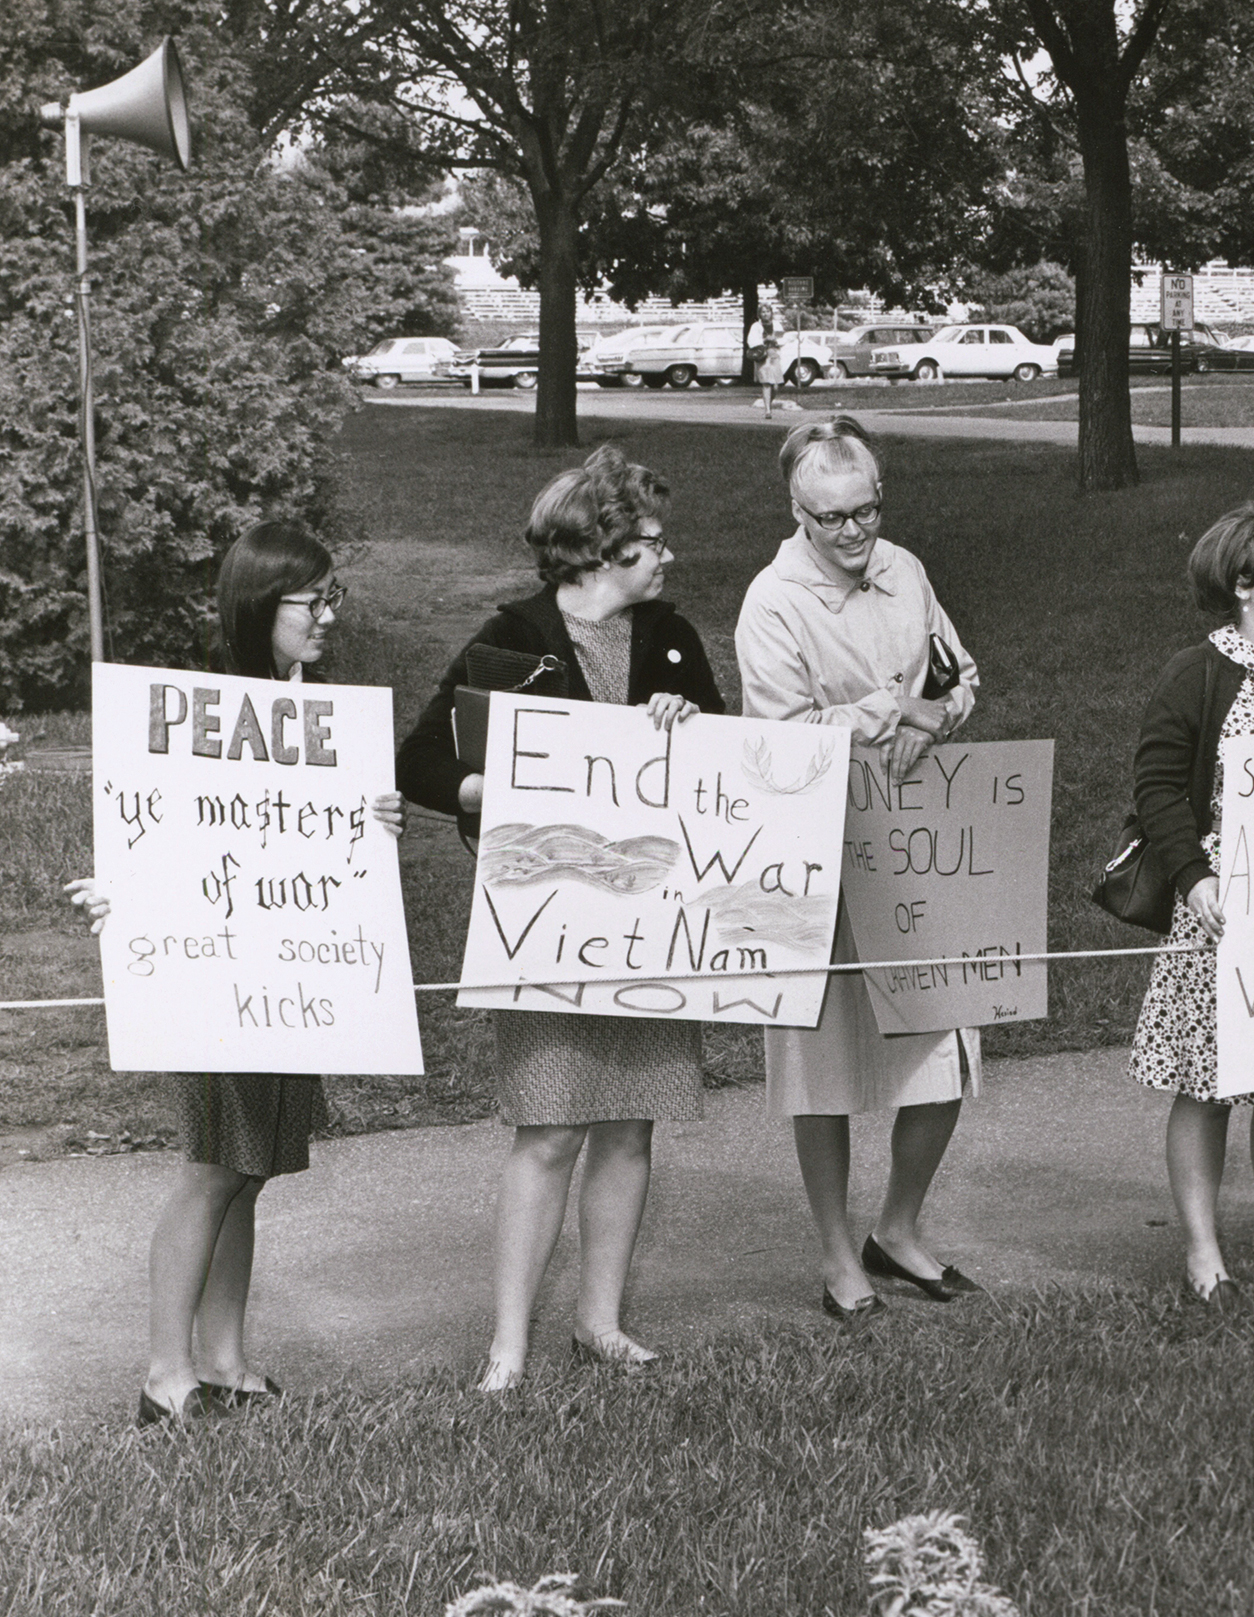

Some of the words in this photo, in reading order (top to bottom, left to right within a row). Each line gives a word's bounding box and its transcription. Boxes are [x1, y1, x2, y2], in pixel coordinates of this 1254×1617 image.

[1171, 279, 1185, 290] NO
[149, 683, 338, 767] PEACE
[511, 708, 672, 809] End
[849, 753, 970, 812] ONEY
[194, 788, 368, 865] masters
[694, 772, 750, 825] the
[678, 813, 823, 897] War
[844, 841, 878, 872] THE
[889, 825, 994, 876] SOUL
[201, 851, 241, 919] of
[663, 886, 684, 904] in
[482, 884, 644, 969] Viet
[666, 906, 768, 972] Nam
[894, 901, 927, 934] OF
[127, 926, 238, 976] great
[278, 925, 385, 994] society
[962, 942, 1021, 985] MEN
[234, 981, 336, 1029] kicks
[513, 975, 784, 1019] NOW
